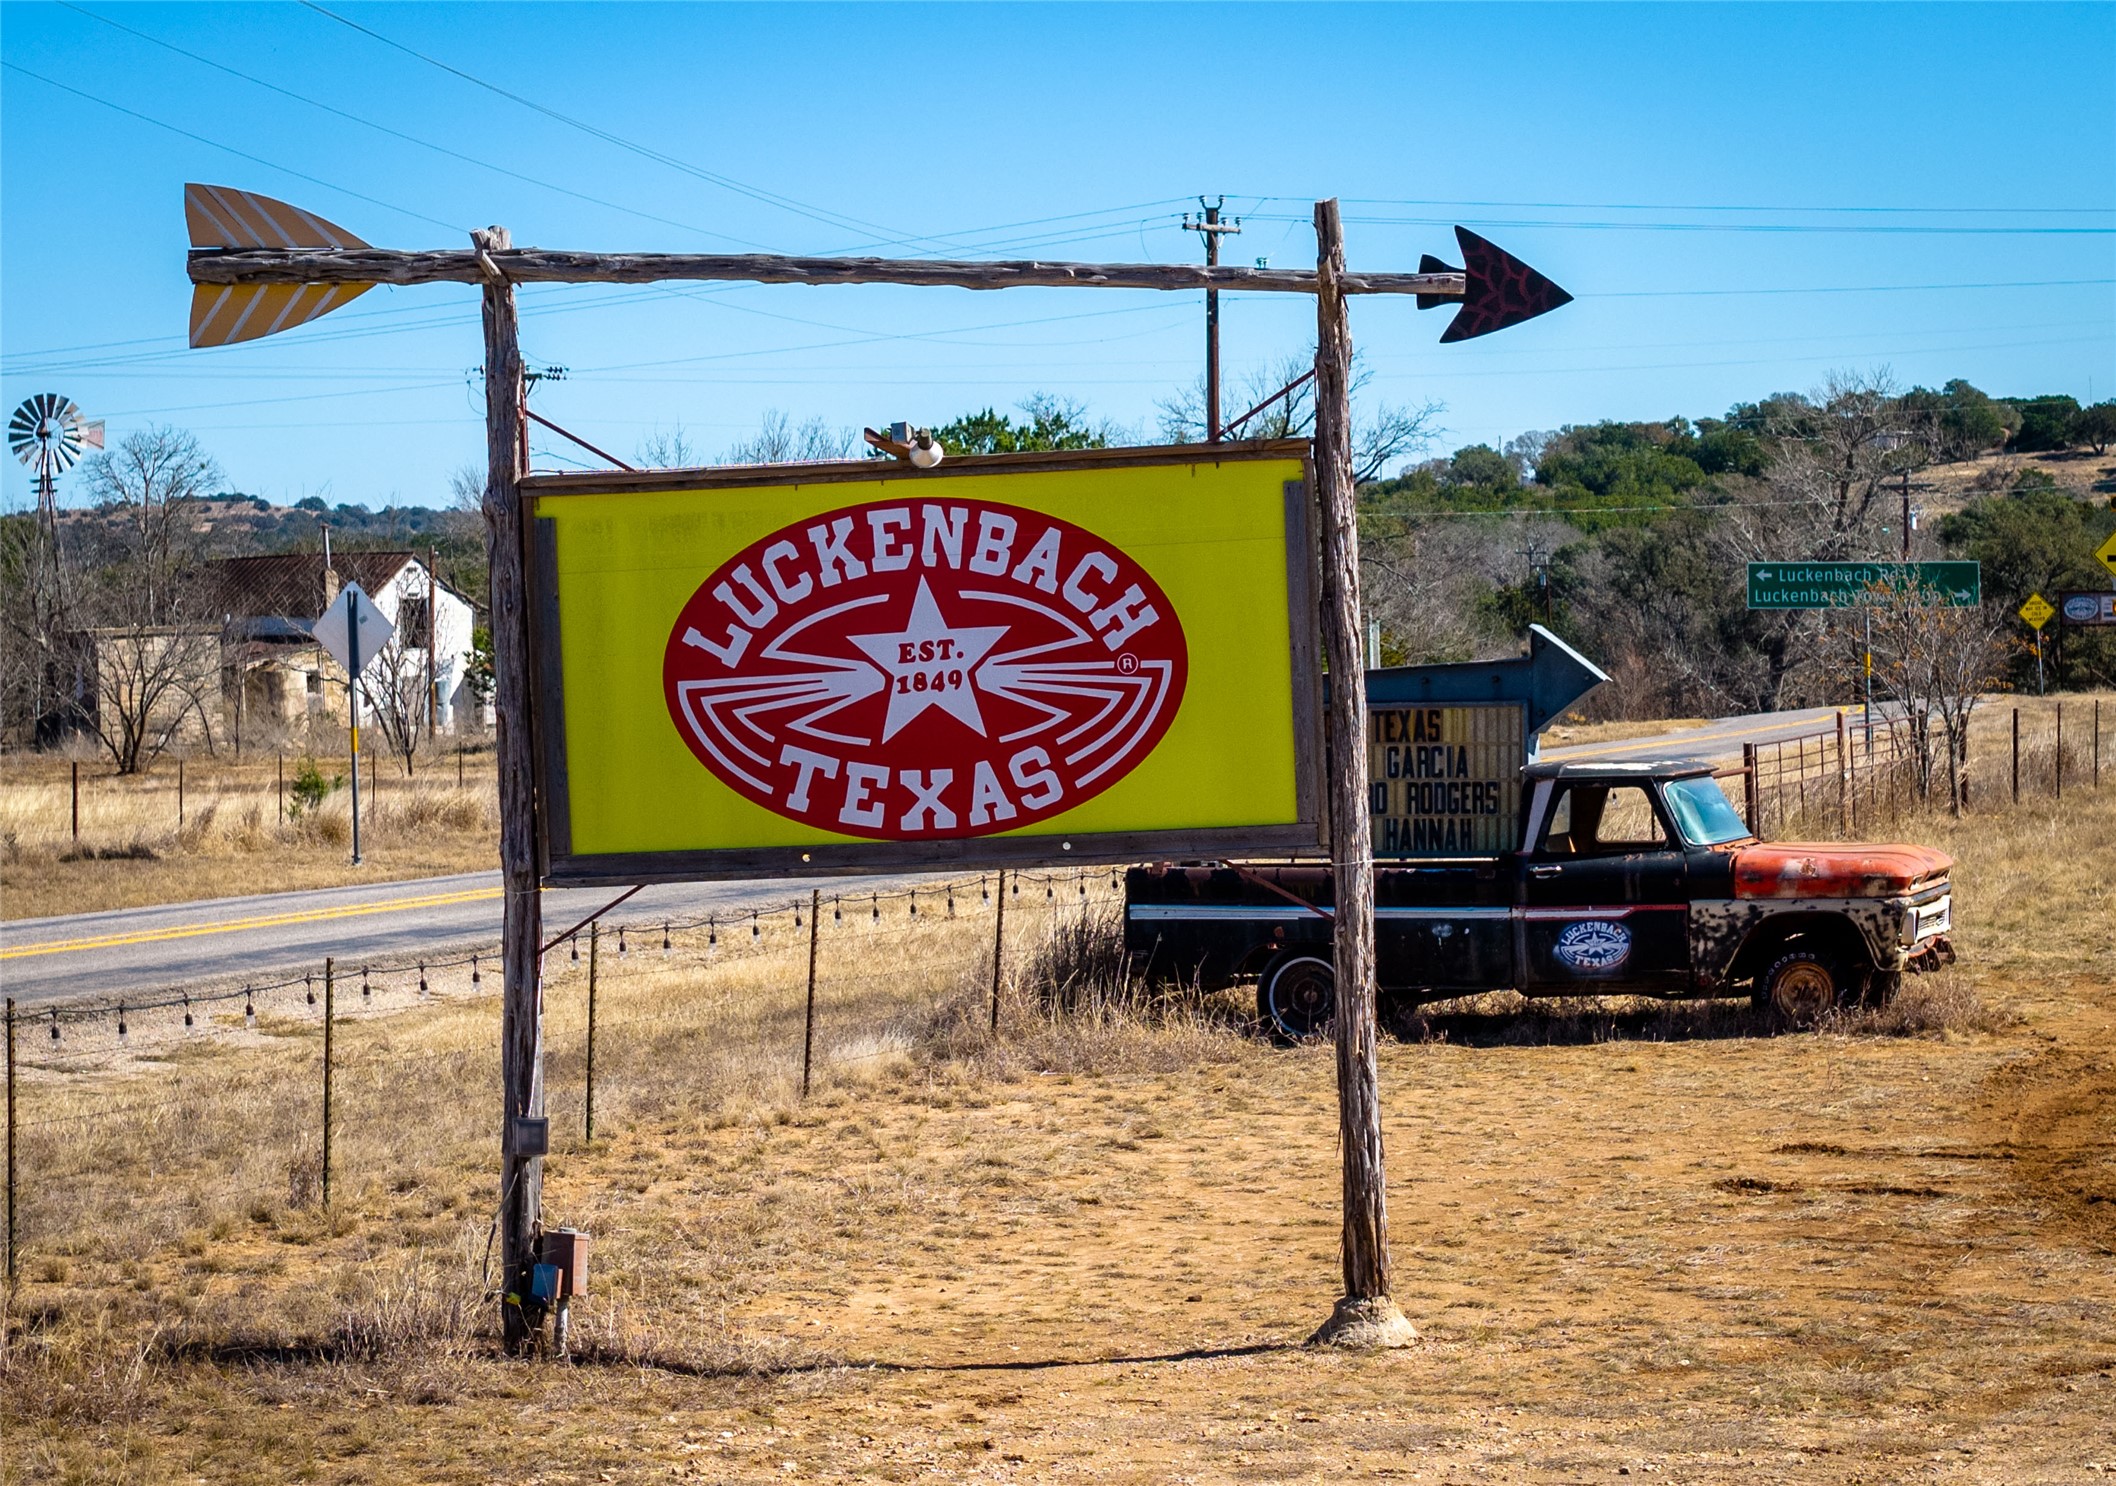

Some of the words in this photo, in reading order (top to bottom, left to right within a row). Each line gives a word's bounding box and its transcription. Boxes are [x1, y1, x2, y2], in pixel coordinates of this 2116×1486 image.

[681, 504, 1160, 669] LUCKENBACH
[1779, 567, 1872, 583] Luckenbach
[1754, 587, 1847, 603] Luckenbach
[897, 638, 965, 664] EST.
[896, 672, 963, 695] 1849
[1371, 709, 1441, 743] TEXAS
[1386, 745, 1468, 779] GARCIA
[778, 745, 1064, 832] TEXAS
[1407, 781, 1499, 814] RODGERS
[1385, 818, 1472, 852] HANNAH
[1560, 921, 1628, 946] LUCKENBACH
[1574, 954, 1614, 968] TEXAS
